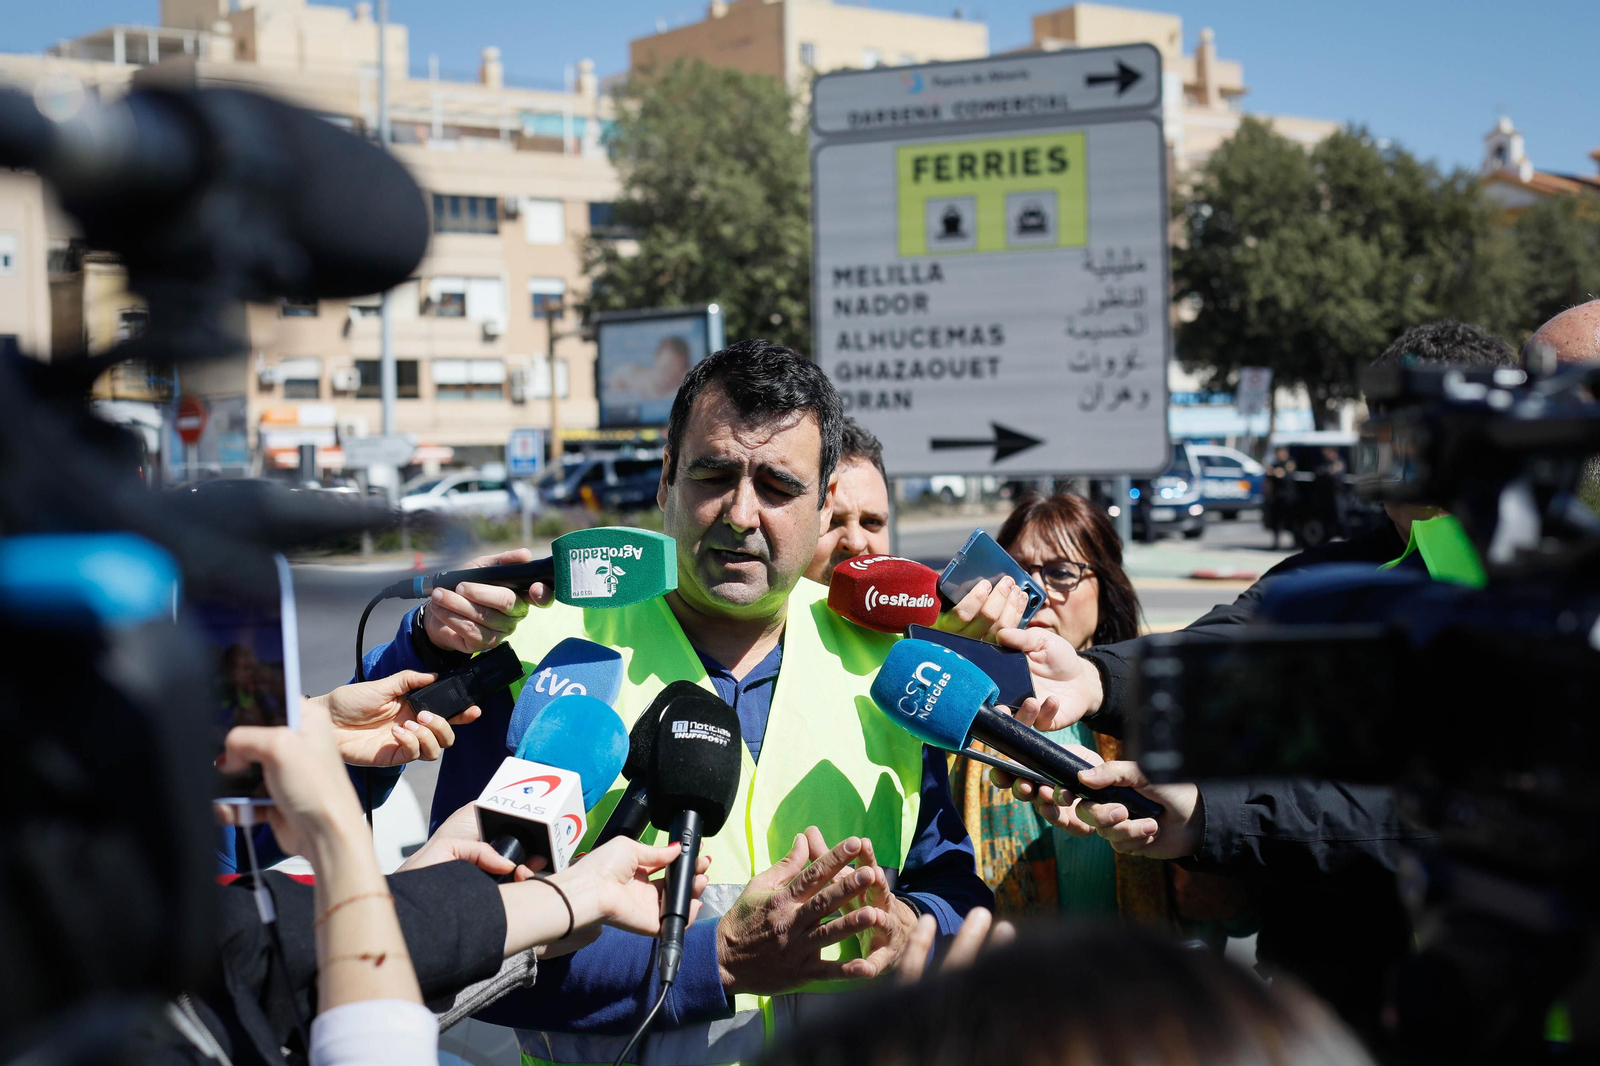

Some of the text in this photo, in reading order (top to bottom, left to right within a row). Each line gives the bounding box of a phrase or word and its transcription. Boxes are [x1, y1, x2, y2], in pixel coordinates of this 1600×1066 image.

[847, 93, 1068, 126] DARSENA COMERCIAL
[912, 146, 1068, 183] FERRIES
[832, 263, 944, 288] MELILLA
[832, 293, 929, 317] NADOR
[836, 323, 1005, 351] ALHUCEMAS
[835, 356, 1000, 382] GHAZAOUET
[571, 544, 643, 563] AgroRadio
[878, 593, 935, 608] esRadio
[918, 672, 951, 720] Noticias
[486, 795, 547, 816] ATLAS
[553, 822, 566, 868] ATLAS
